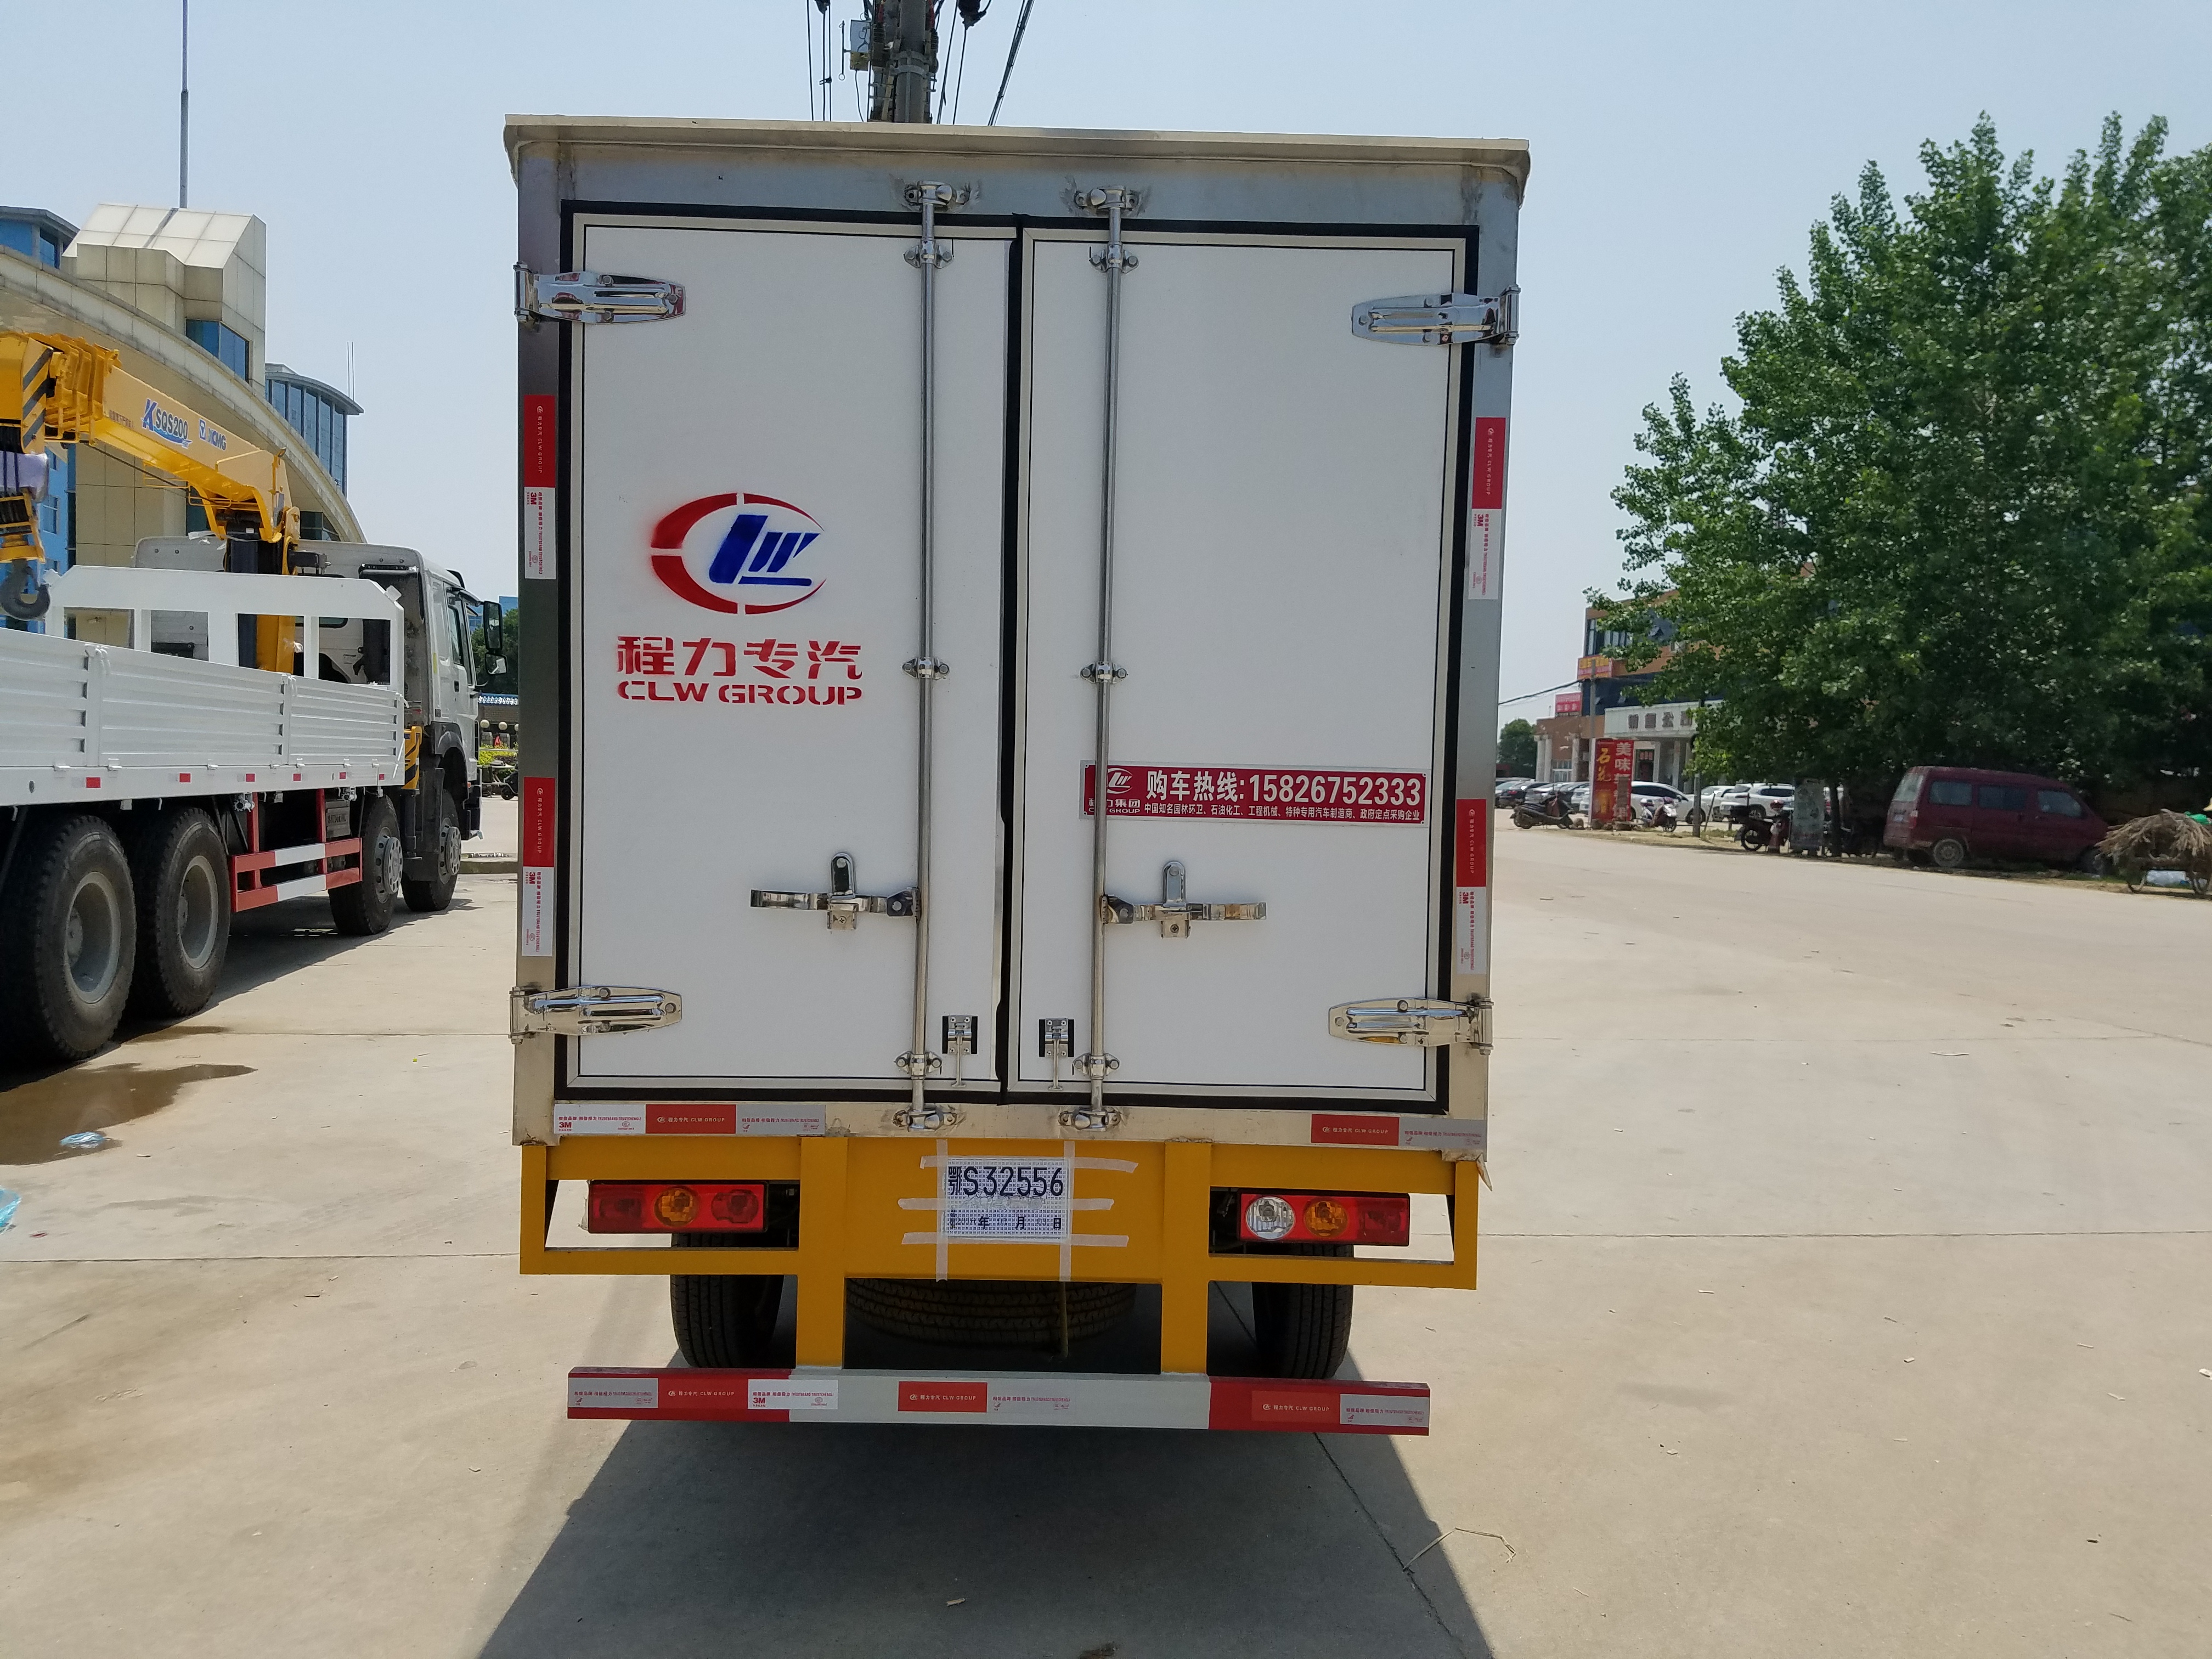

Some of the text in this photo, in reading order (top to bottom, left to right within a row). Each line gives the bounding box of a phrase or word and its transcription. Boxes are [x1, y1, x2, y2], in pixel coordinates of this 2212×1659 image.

[156, 408, 188, 440] SQS200
[531, 492, 537, 505] 3M
[1477, 514, 1483, 527] 3M
[617, 636, 863, 680] 程力专汽
[617, 680, 862, 706] CLW GROUP
[529, 872, 535, 884] 3M
[1463, 892, 1469, 904] 3M
[948, 1166, 1063, 1197] 鄂S32556
[978, 1216, 990, 1229] 年
[1015, 1216, 1025, 1229] 月
[1053, 1218, 1061, 1229] 日
